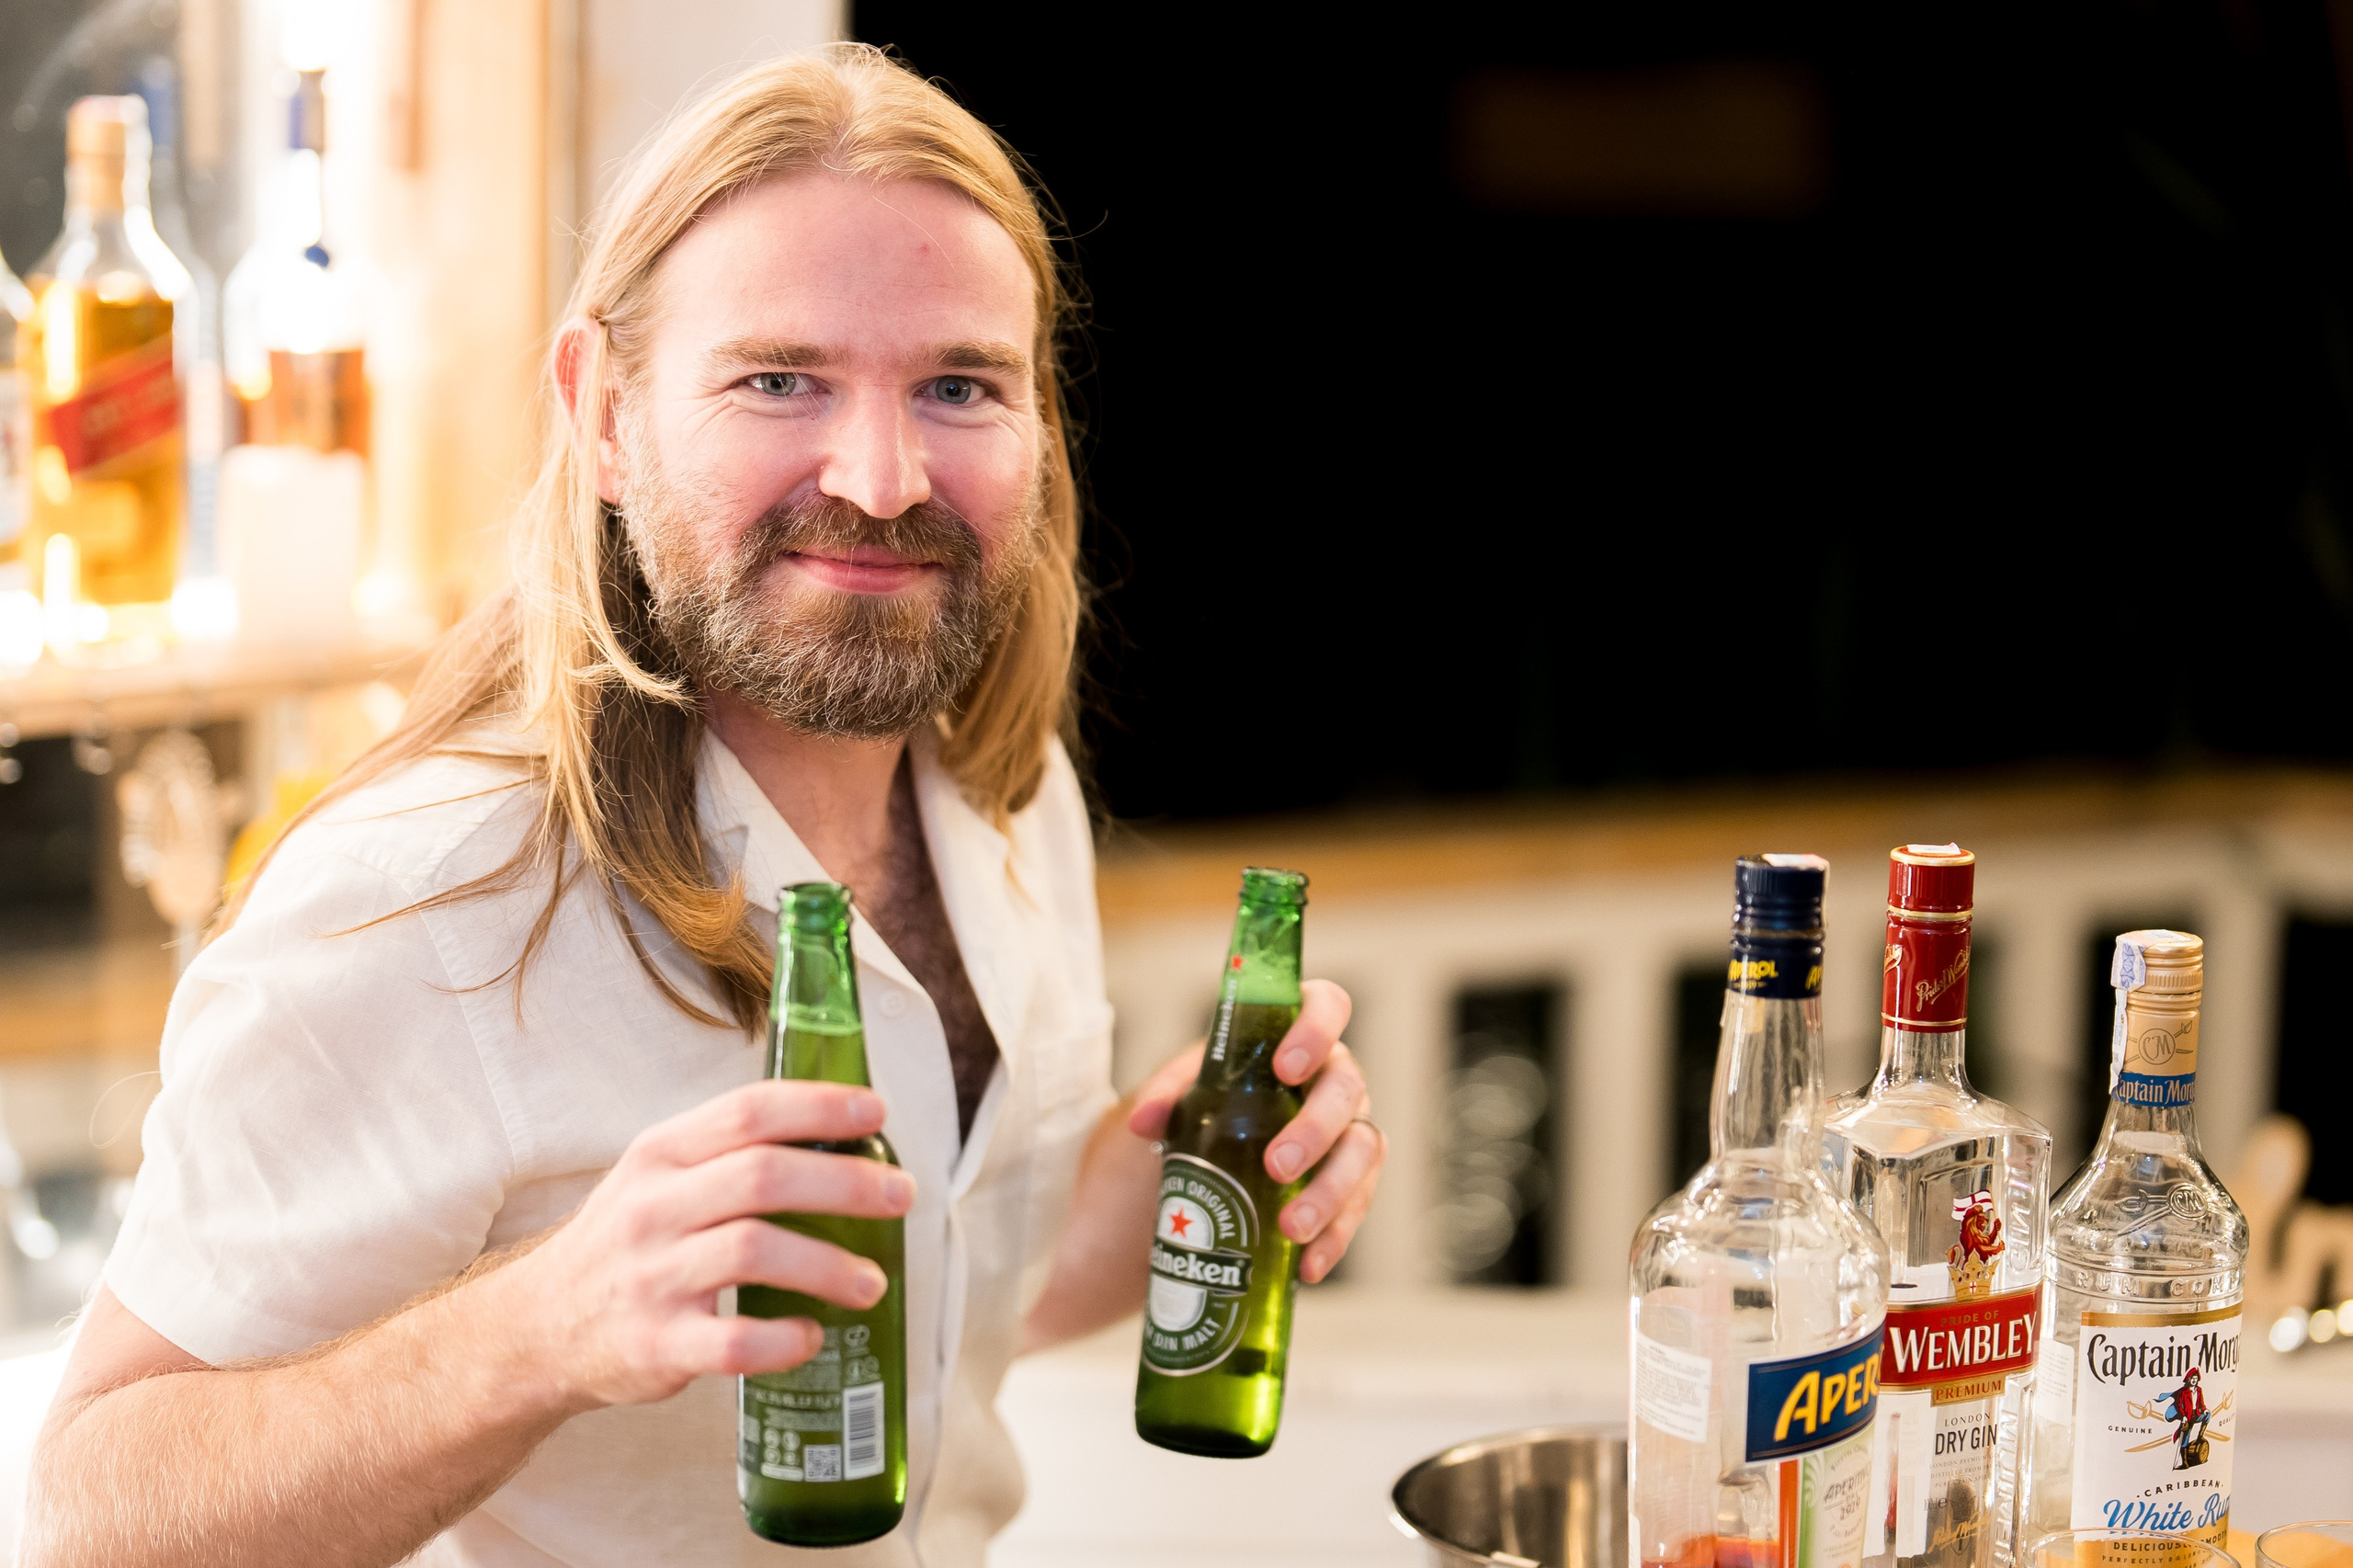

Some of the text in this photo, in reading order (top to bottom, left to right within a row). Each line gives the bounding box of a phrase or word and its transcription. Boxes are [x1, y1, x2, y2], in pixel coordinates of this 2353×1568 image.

[1210, 978, 1238, 1062] Heineken
[2143, 1035, 2172, 1062] CM
[1186, 1179, 1236, 1240] ORIGINAL
[1180, 1316, 1222, 1351] MALT
[1940, 1310, 2000, 1326] PRIDE OF
[1889, 1311, 2038, 1374] WEMBLEY
[2087, 1334, 2191, 1386] Captain
[1773, 1343, 1885, 1443] APER
[1935, 1380, 2003, 1401] PREMIUM
[1944, 1412, 1991, 1427] LONDON
[2108, 1425, 2154, 1435] GENUINE
[1935, 1424, 1998, 1455] DRY GIN
[2103, 1498, 2194, 1532] White
